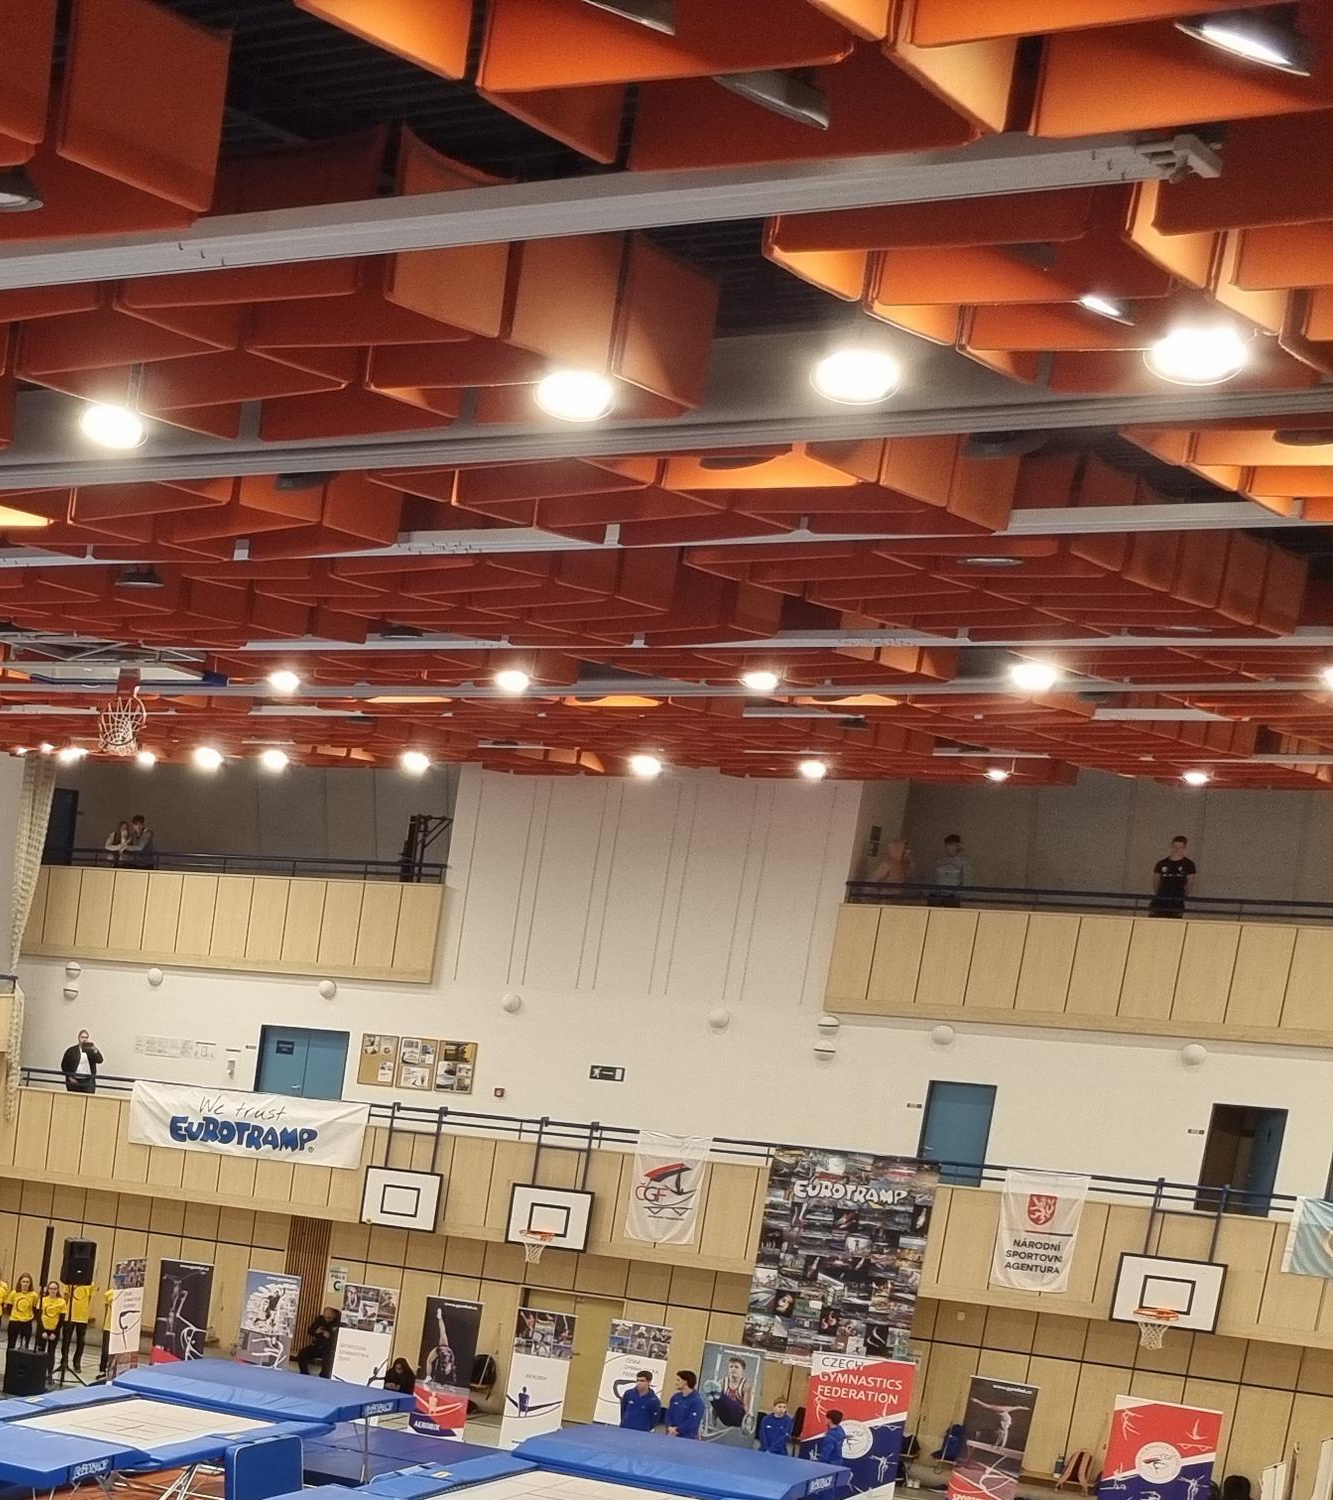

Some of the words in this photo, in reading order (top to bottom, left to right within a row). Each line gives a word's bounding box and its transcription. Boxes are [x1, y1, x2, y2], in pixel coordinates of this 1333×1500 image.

[198, 1095, 225, 1115] We
[236, 1101, 286, 1121] trust
[169, 1115, 318, 1152] EUROTRAMP
[635, 1181, 668, 1202] ČGF
[793, 1179, 908, 1205] EUROTRAMP
[1013, 1237, 1061, 1252] NÁRODNÍ
[1005, 1249, 1063, 1263] SPORTOVN
[1004, 1261, 1060, 1274] AGENTURA
[333, 1280, 342, 1291] C
[821, 1356, 865, 1371] CZECH
[818, 1370, 903, 1391] GYMNASTICS
[817, 1384, 899, 1405] FEDERATION
